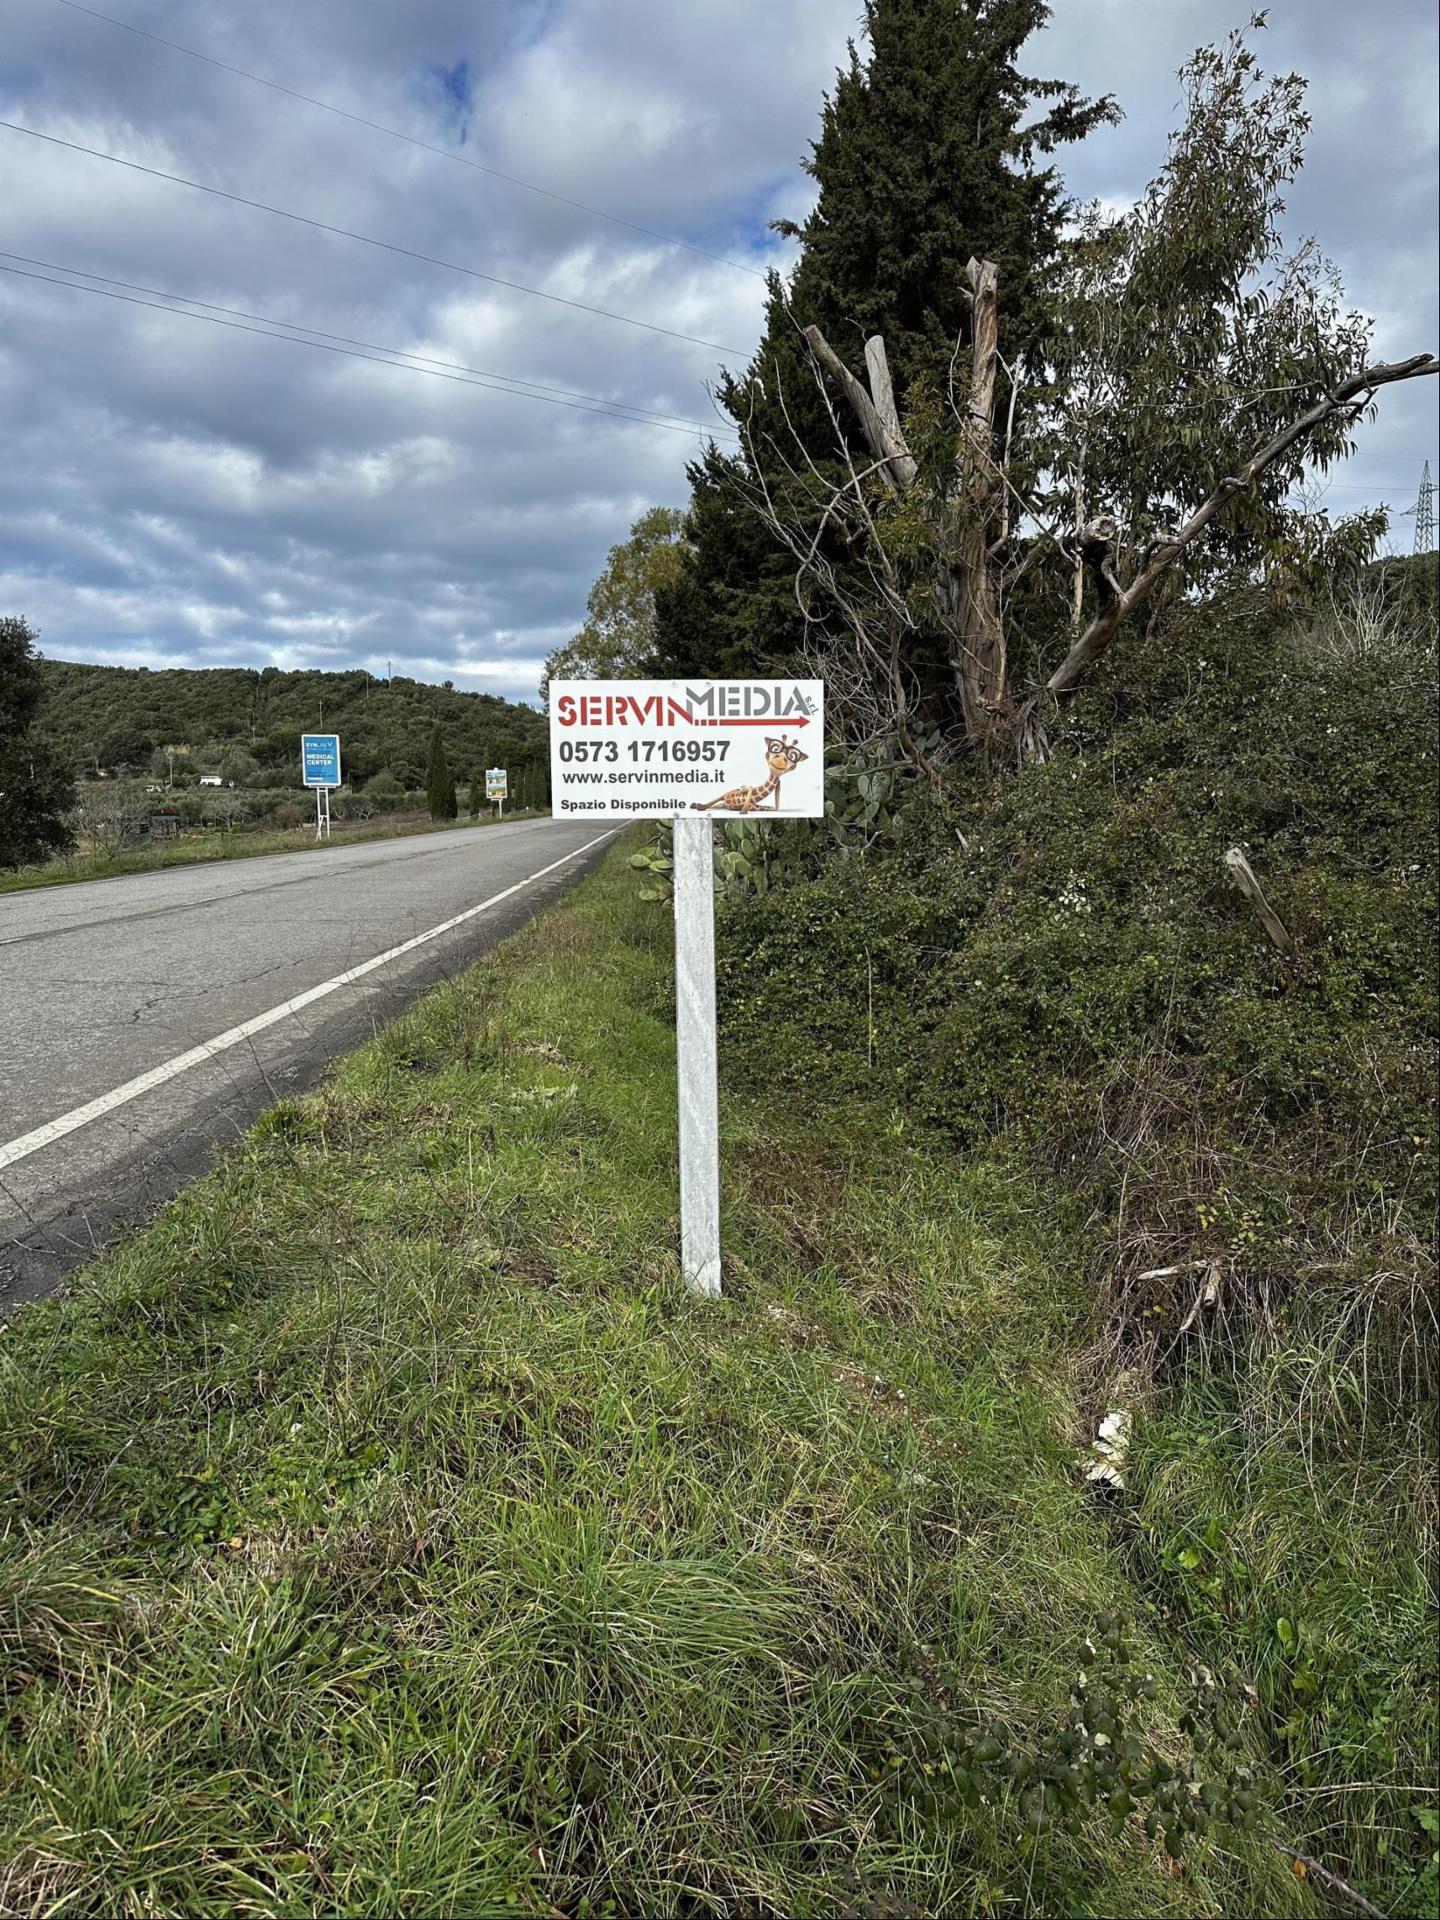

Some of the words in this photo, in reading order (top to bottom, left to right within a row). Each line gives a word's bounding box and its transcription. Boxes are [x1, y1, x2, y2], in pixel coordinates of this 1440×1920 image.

[559, 740, 619, 763] 0573
[627, 740, 731, 762] 1716957
[562, 769, 726, 784] www.servinmedia.it
[561, 799, 606, 812] Spazio
[610, 798, 687, 812] Disponibile
